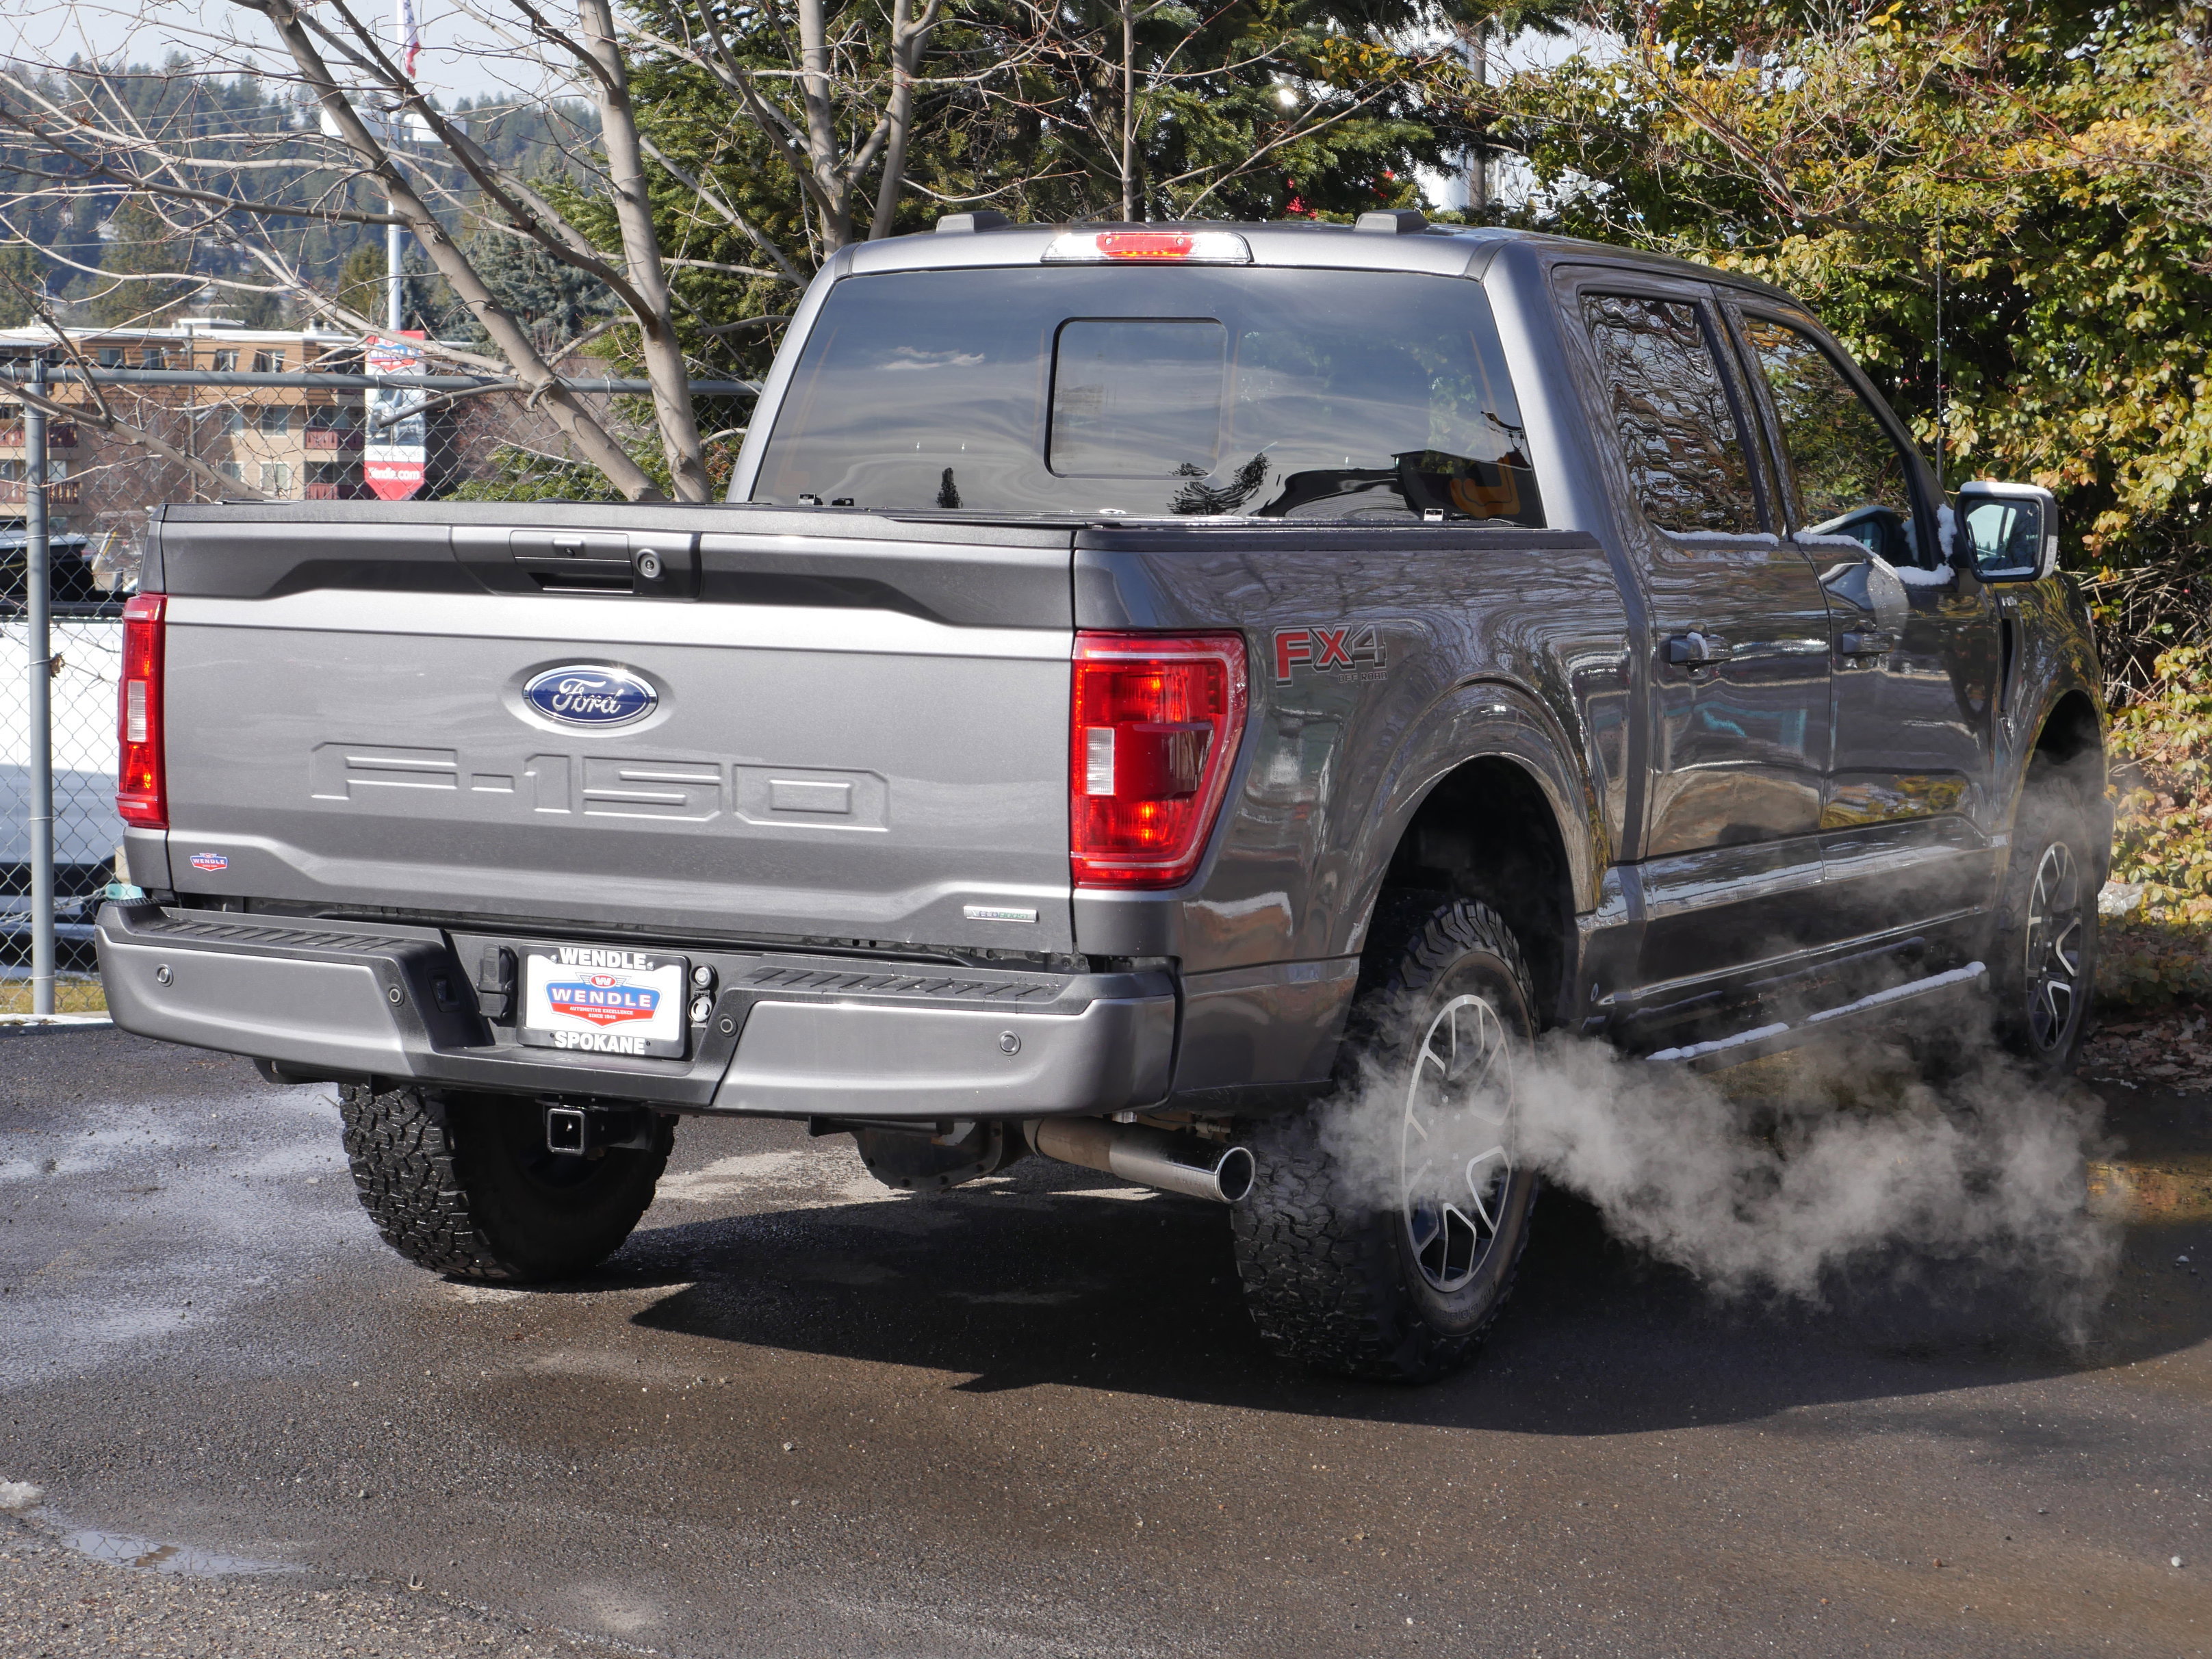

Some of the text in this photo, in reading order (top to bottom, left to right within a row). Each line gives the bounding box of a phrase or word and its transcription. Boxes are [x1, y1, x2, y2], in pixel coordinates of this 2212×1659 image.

[1271, 621, 1387, 688] FX4
[1338, 671, 1387, 683] OFF ROAD
[552, 678, 624, 714] Ford
[311, 741, 890, 831] F-150
[559, 947, 647, 970] WENDLE
[594, 977, 612, 986] W
[552, 988, 652, 1007] WENDLE
[554, 1031, 645, 1055] SPOKANE
